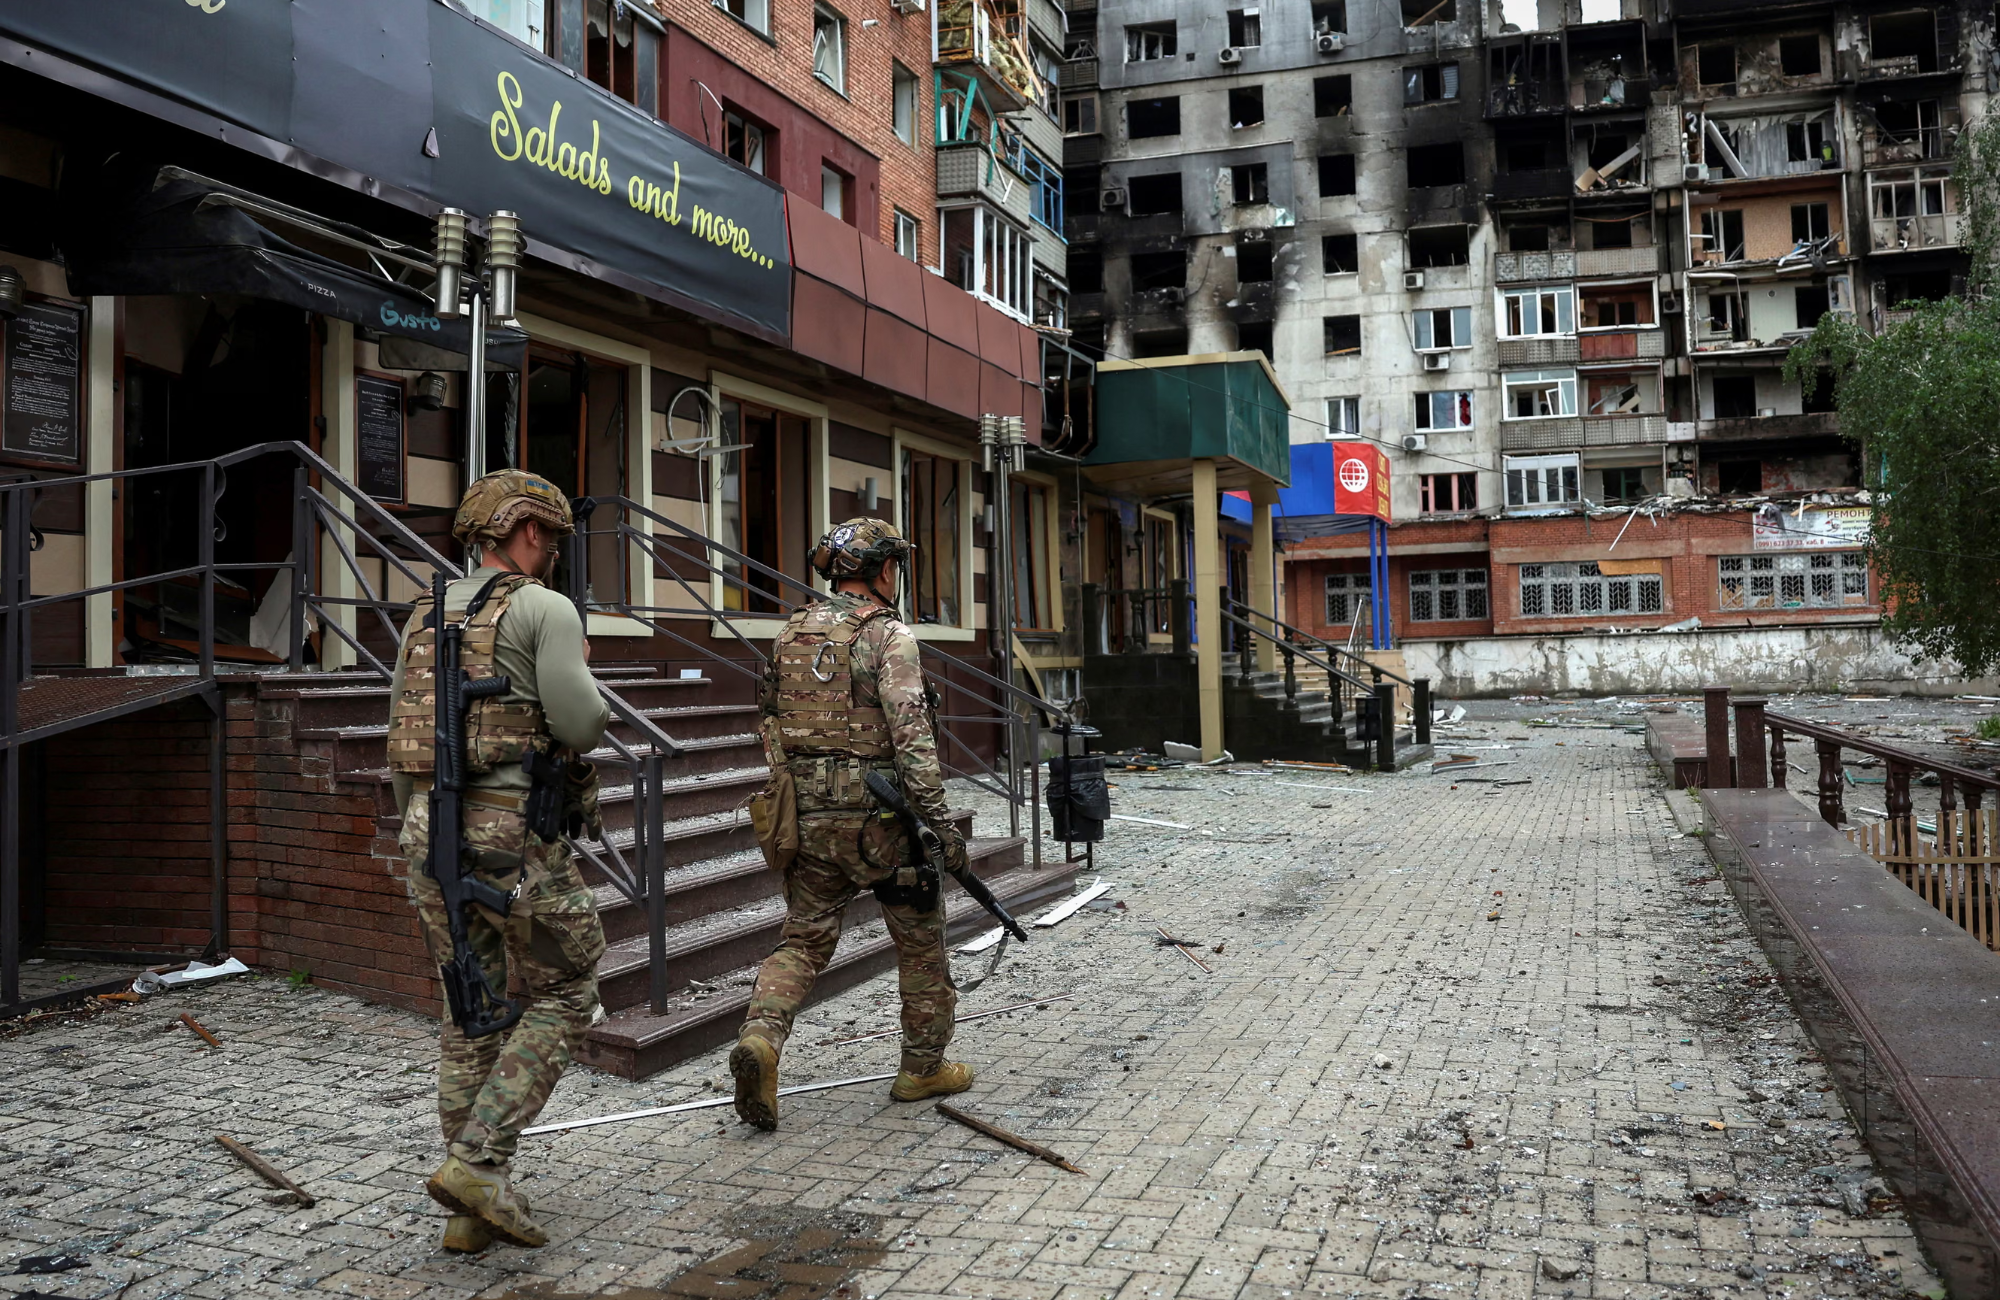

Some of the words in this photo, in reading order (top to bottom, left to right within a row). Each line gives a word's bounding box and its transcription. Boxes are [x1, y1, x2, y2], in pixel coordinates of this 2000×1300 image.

[490, 71, 612, 195] Salads
[628, 161, 682, 226] and
[691, 204, 774, 269] more...
[307, 283, 336, 299] PIZZA
[380, 300, 441, 331] Gusto
[1827, 509, 1871, 518] РЕМОНТ
